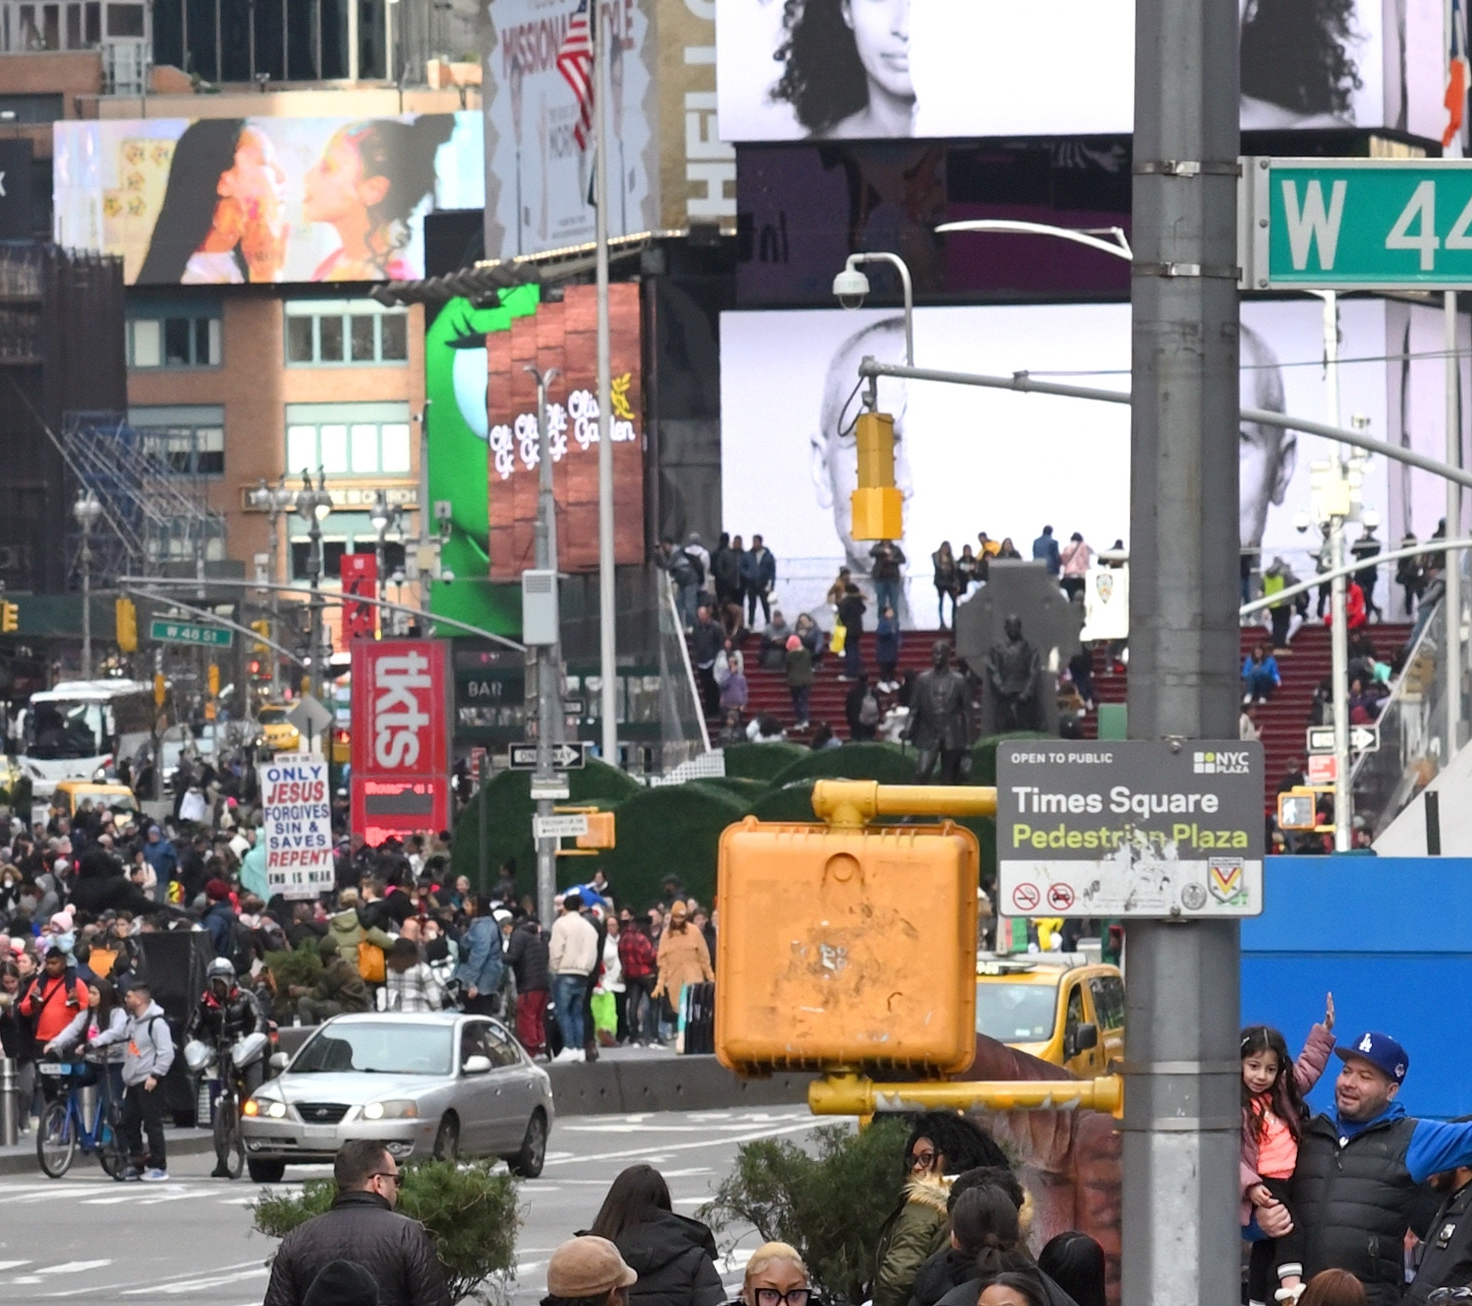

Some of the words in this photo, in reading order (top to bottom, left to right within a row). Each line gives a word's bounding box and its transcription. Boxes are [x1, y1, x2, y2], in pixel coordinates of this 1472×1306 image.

[1280, 179, 1348, 272] W
[166, 627, 178, 638] W
[181, 629, 199, 640] 48
[203, 630, 217, 643] St
[468, 681, 502, 697] BAR
[375, 651, 432, 769] tkts
[1011, 753, 1048, 766] OPEN
[1052, 753, 1068, 766] TO
[1071, 752, 1113, 766] PUBLIC
[1215, 752, 1249, 765] NYC
[267, 767, 322, 782] ONLY
[1215, 765, 1250, 774] PLAZA
[267, 781, 324, 804] JESUS
[1011, 786, 1102, 814] Times
[1109, 786, 1219, 818] Square
[265, 804, 330, 822] FORGIVES
[275, 823, 302, 836] SIN
[309, 822, 319, 834] &
[1172, 823, 1249, 849] Plaza
[270, 835, 327, 849] SAVES
[268, 850, 330, 867] REPENT
[269, 872, 286, 884] END
[293, 871, 303, 884] IS
[309, 869, 332, 882] NEAR
